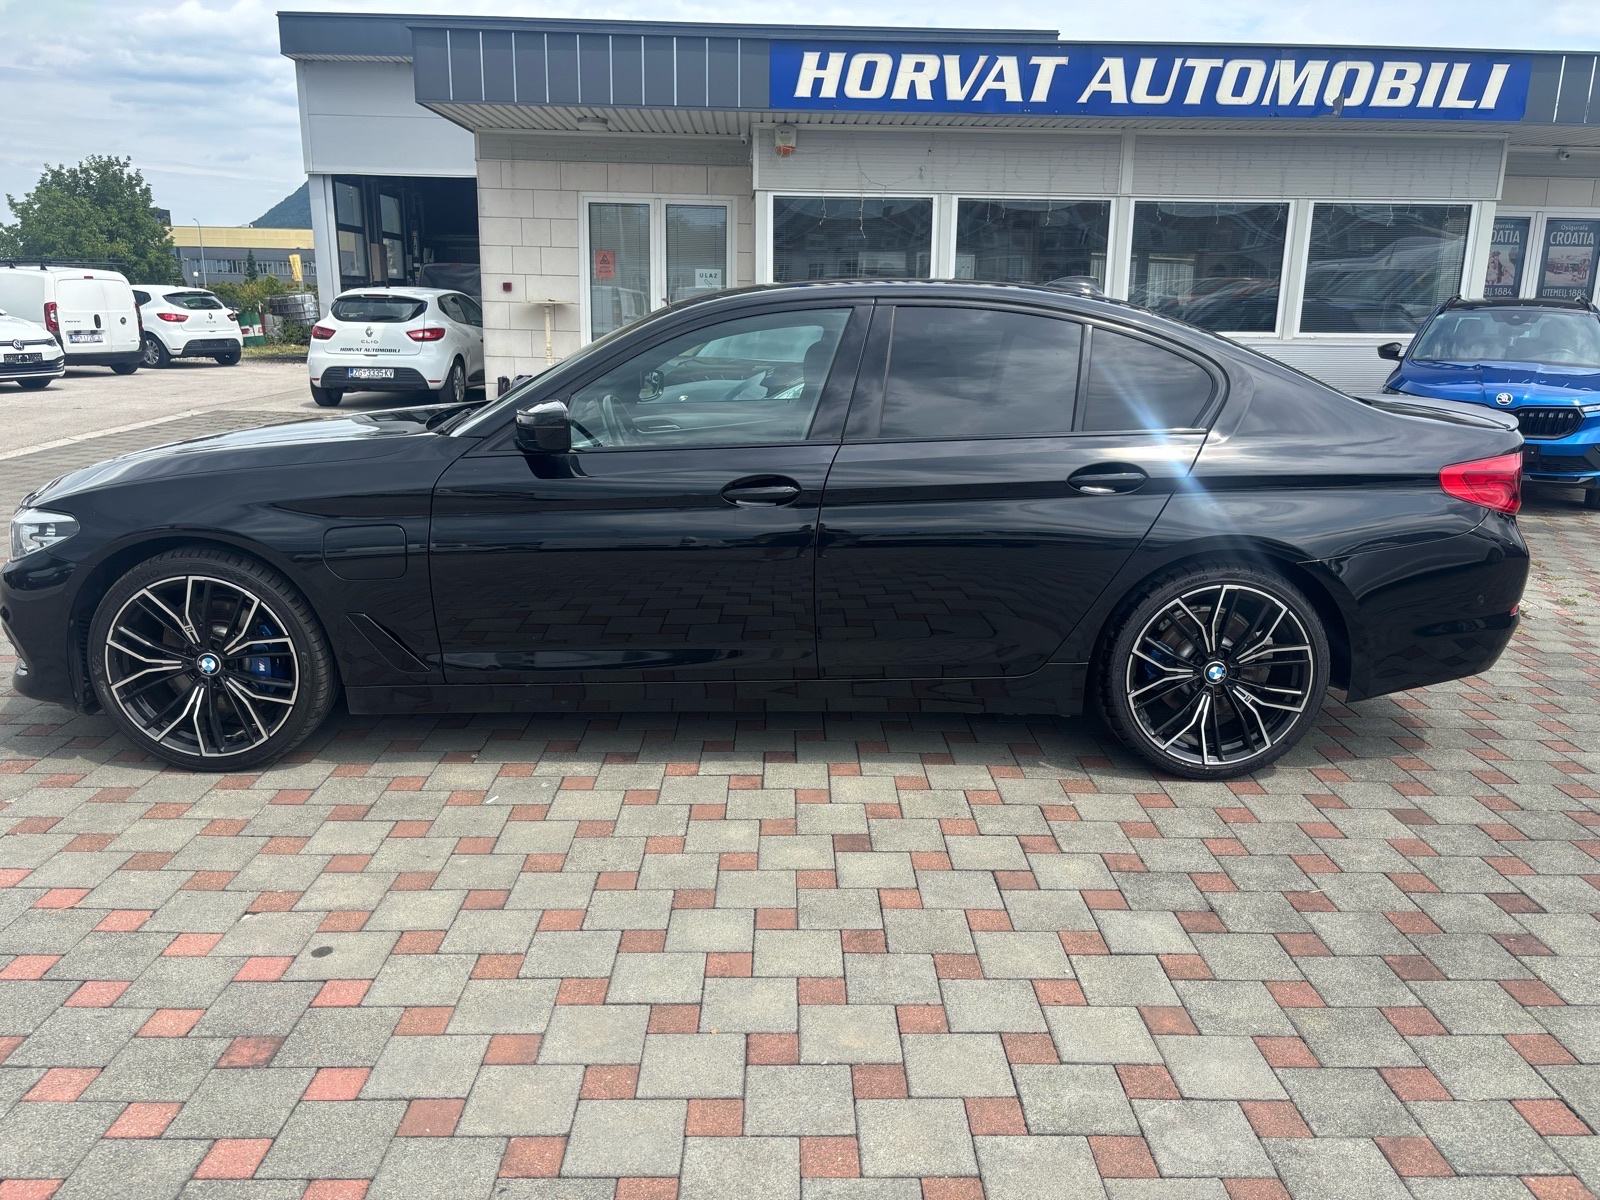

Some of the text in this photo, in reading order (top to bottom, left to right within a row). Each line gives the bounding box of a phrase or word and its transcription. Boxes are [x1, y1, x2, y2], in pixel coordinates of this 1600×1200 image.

[794, 52, 1510, 109] HORVAT AUTOMOBILI
[1550, 231, 1594, 245] CROATIA
